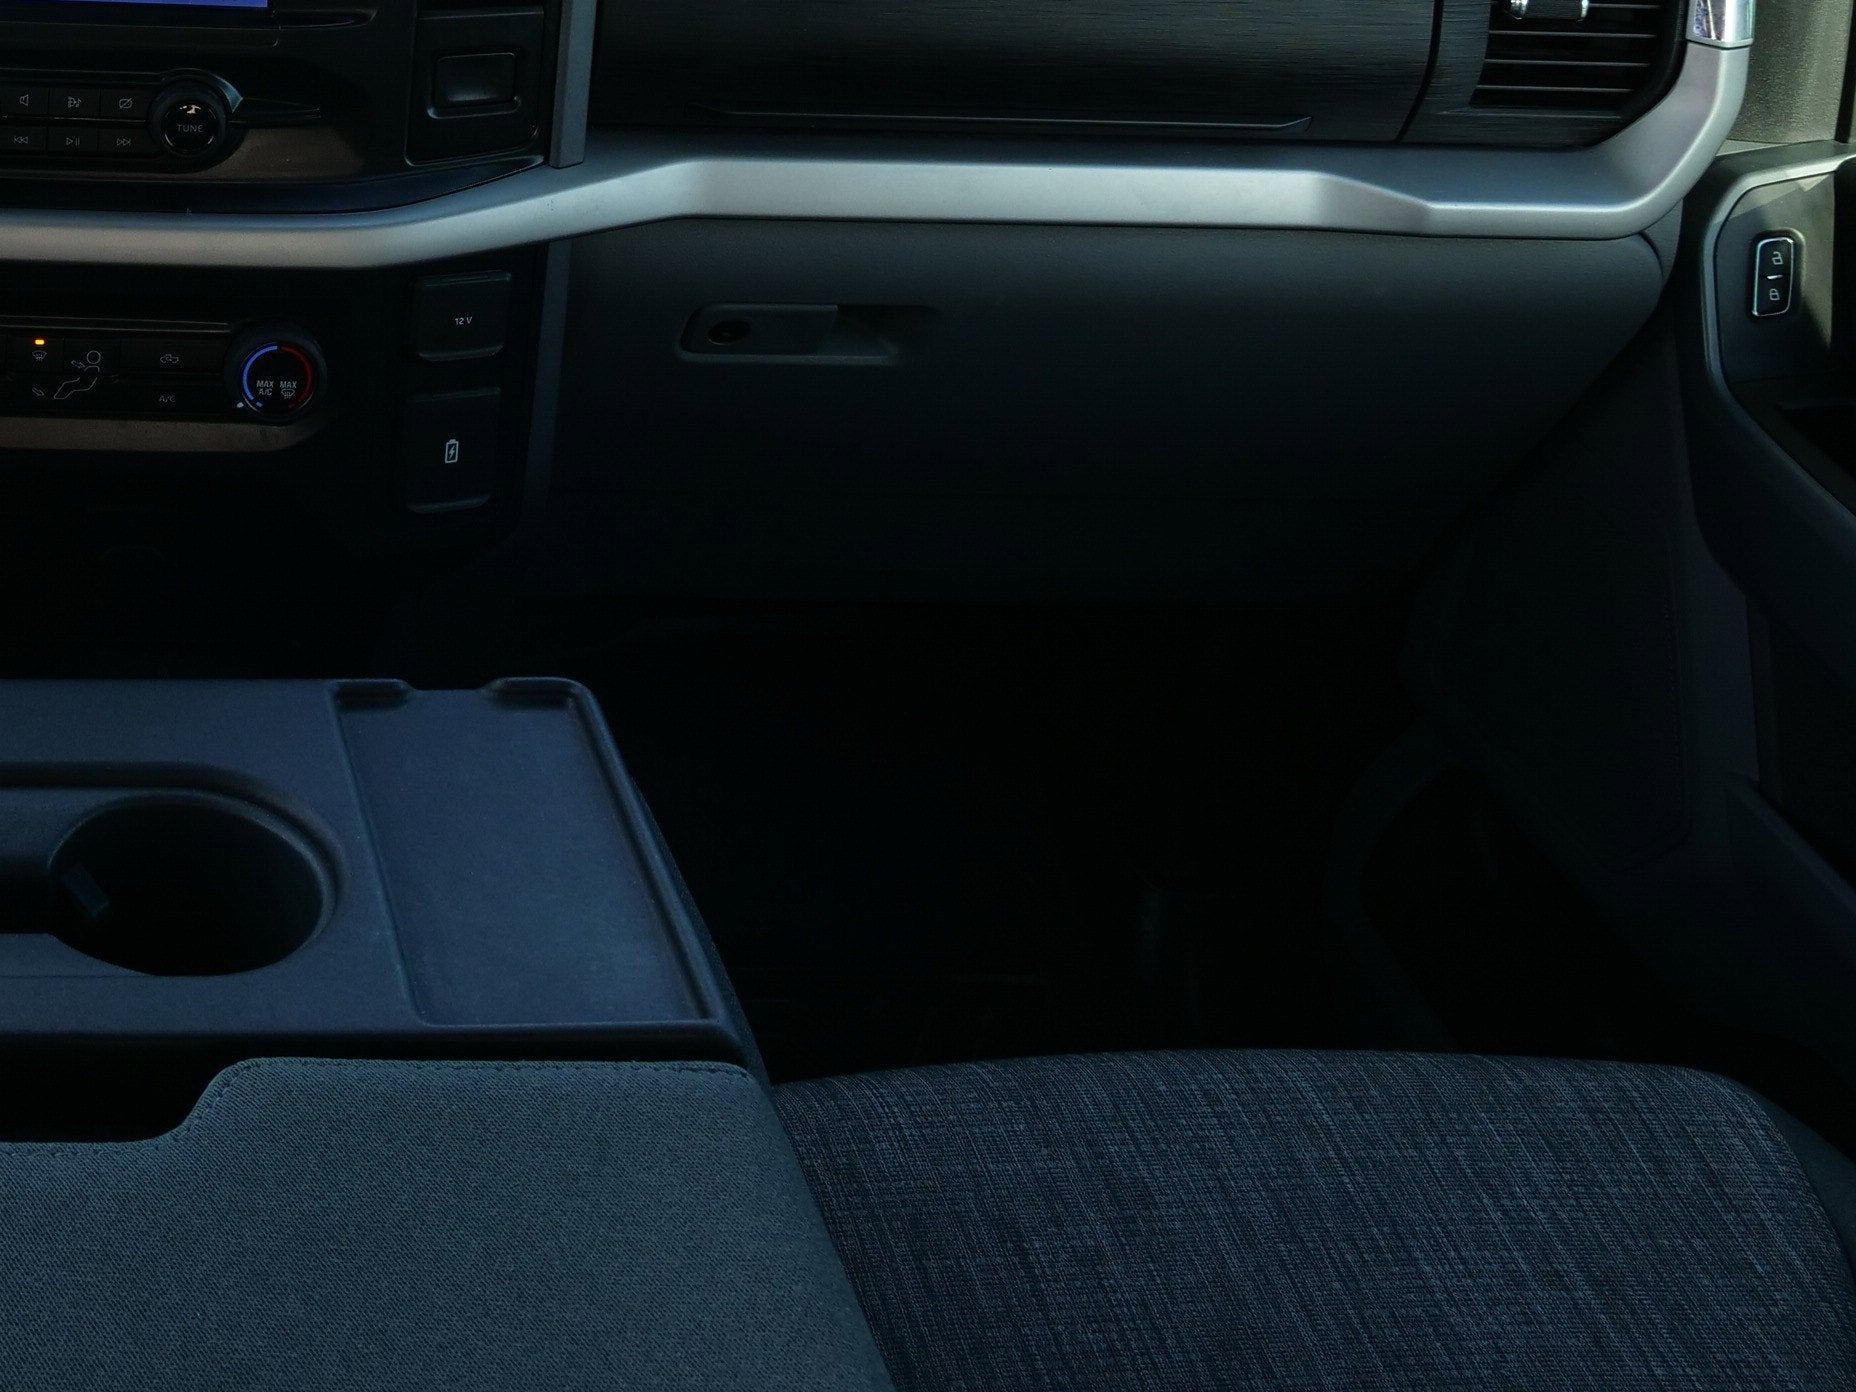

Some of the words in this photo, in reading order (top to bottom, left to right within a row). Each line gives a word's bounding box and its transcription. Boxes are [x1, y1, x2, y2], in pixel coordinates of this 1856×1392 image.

[176, 124, 204, 133] TUNE
[256, 380, 274, 388] MAX
[278, 380, 297, 389] MAX
[258, 388, 273, 396] A/C
[158, 394, 176, 403] A/C
